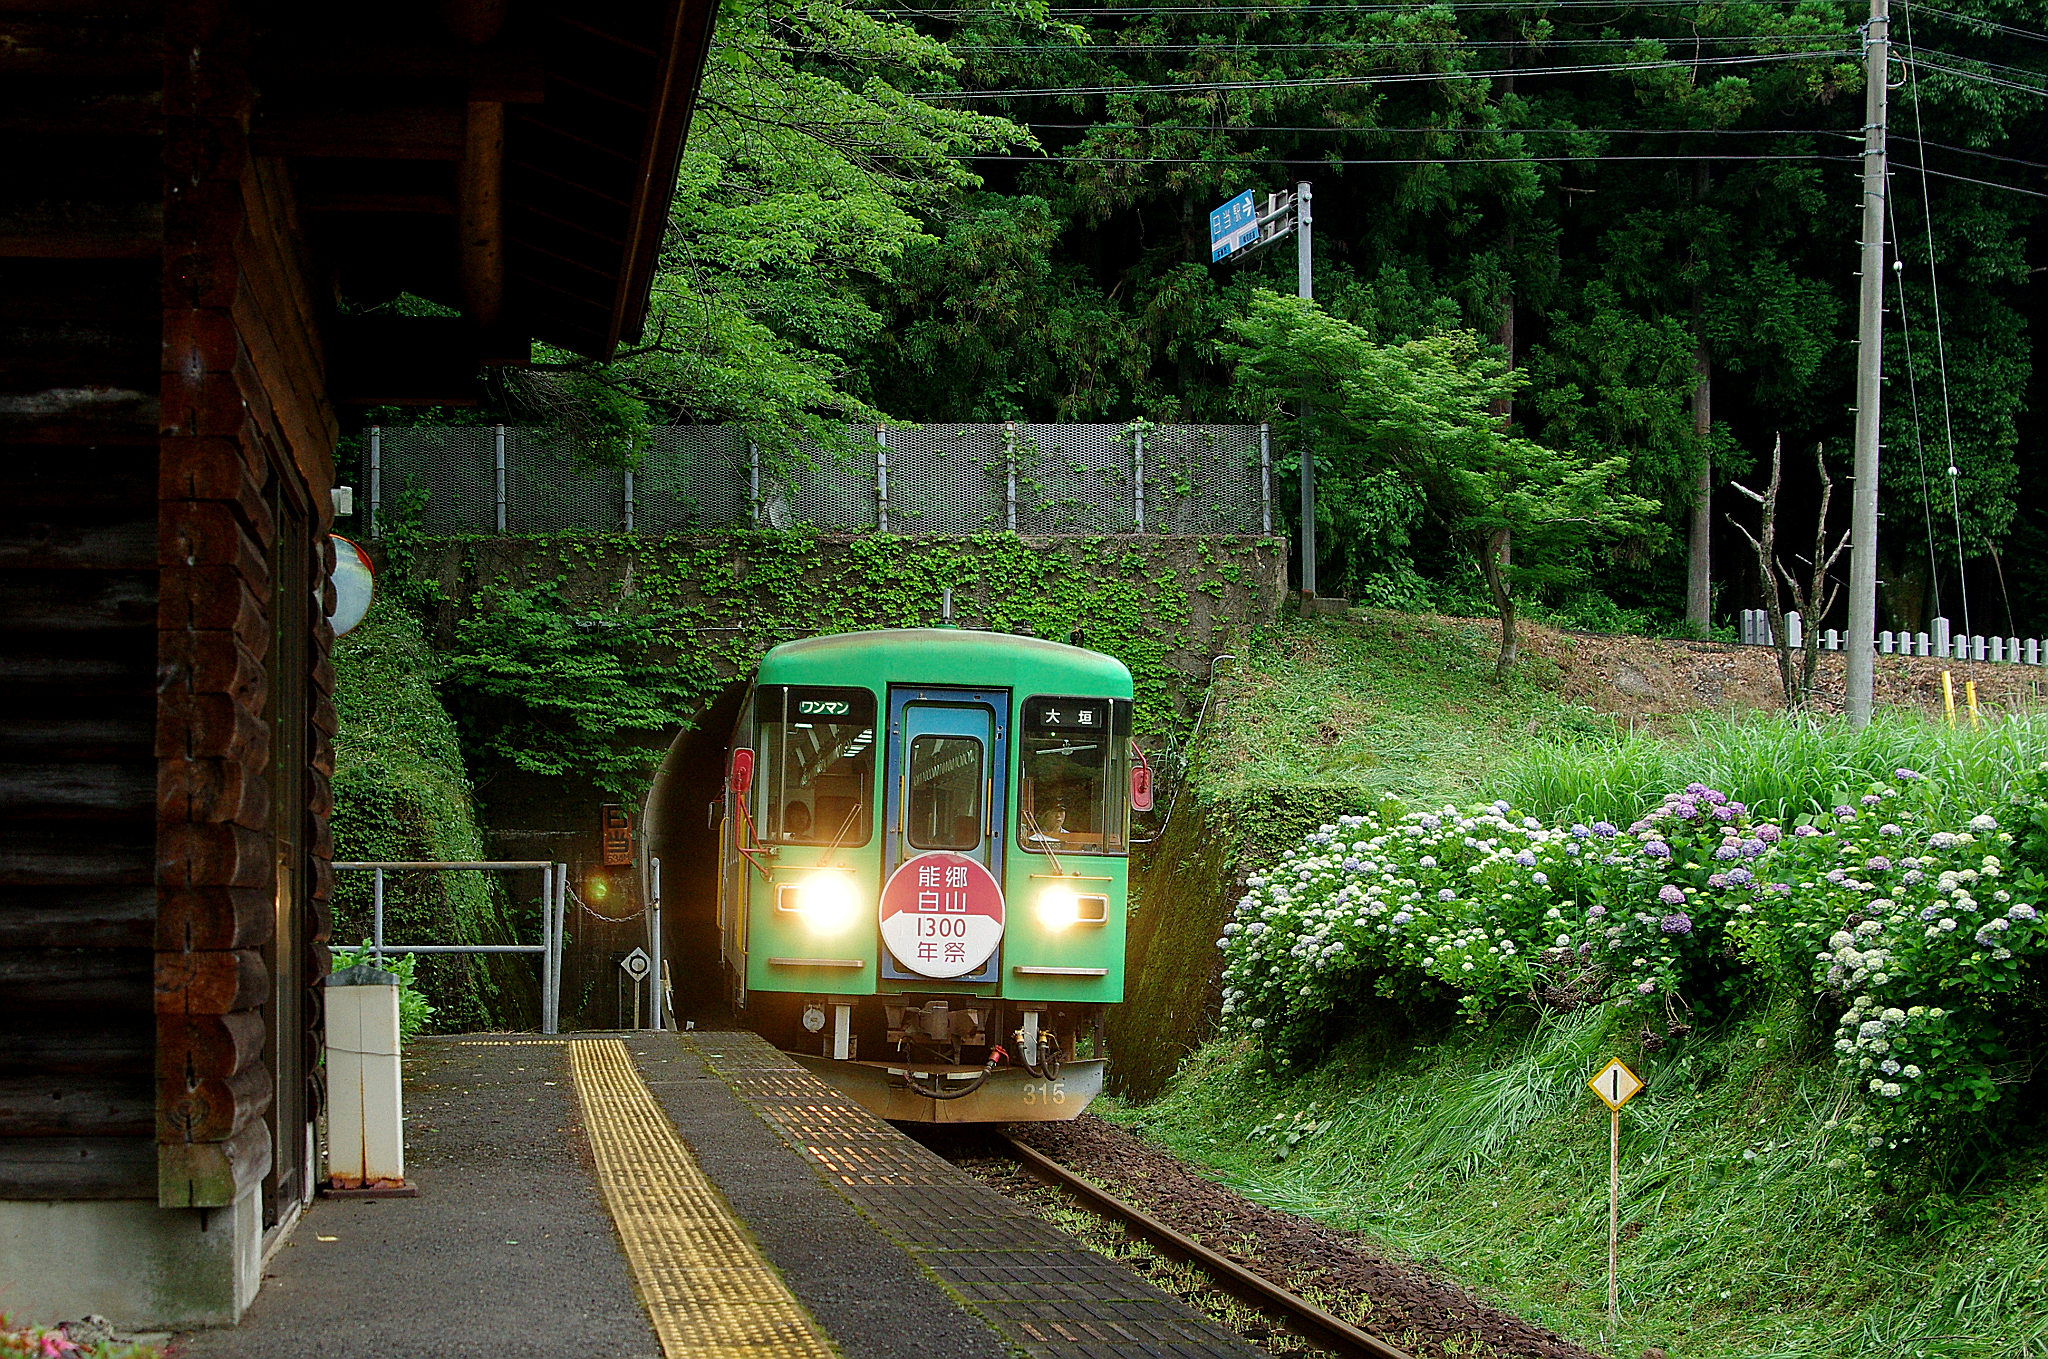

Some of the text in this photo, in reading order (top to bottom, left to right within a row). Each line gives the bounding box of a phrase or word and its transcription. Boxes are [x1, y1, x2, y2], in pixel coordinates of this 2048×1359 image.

[801, 701, 849, 714] ワンマン
[918, 865, 968, 888] 能郷
[918, 890, 967, 912] 白山
[917, 917, 967, 937] 1300
[917, 941, 966, 963] 年祭
[1023, 1083, 1066, 1105] 315
